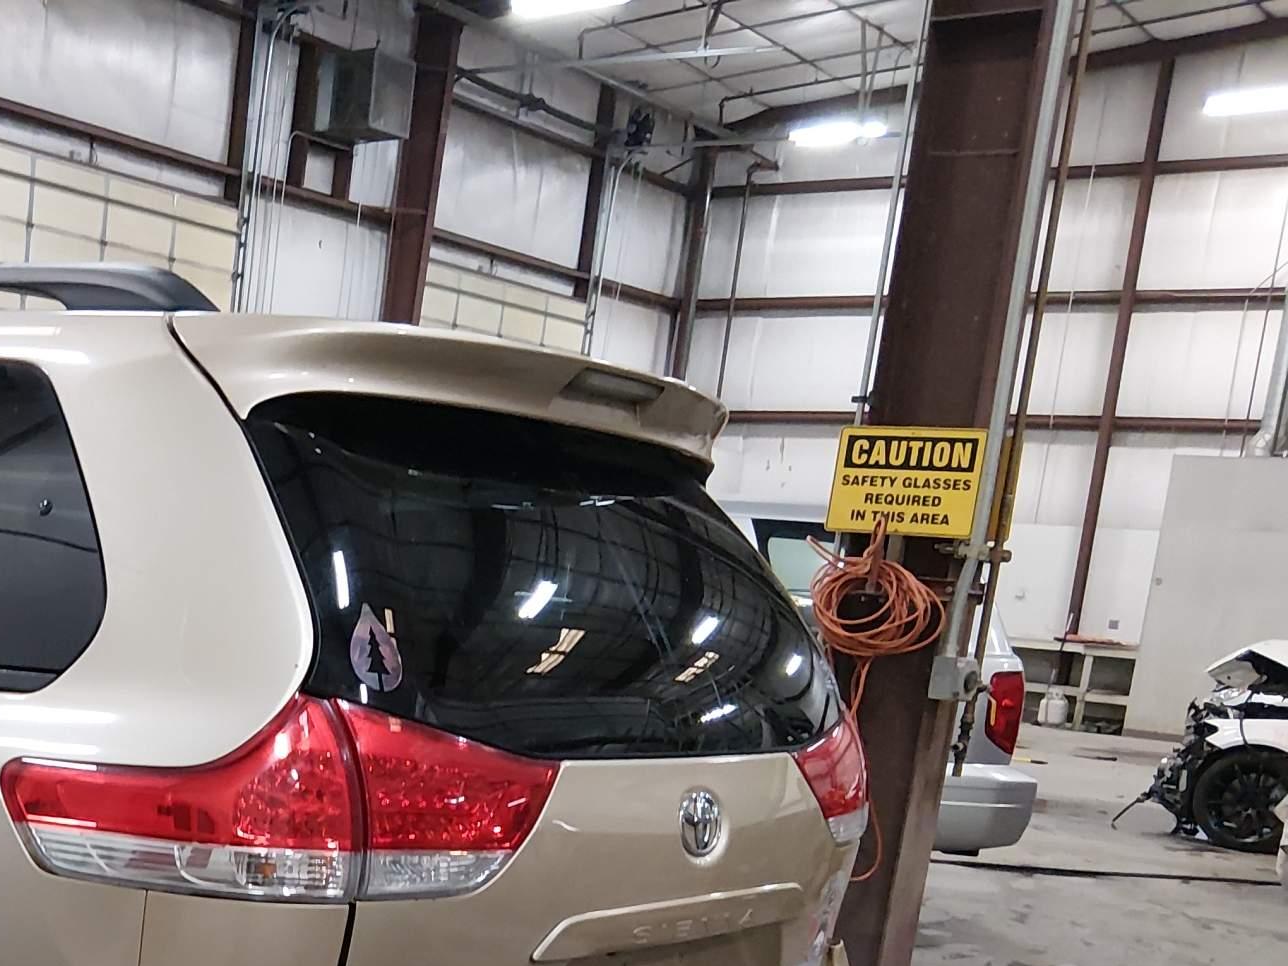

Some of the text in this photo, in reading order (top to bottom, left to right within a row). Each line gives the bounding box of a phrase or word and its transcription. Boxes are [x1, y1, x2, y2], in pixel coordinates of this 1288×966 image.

[851, 438, 973, 469] CAUTION
[841, 474, 972, 492] SAFETY GLASSES
[863, 492, 942, 508] REQUIRED
[850, 509, 867, 521] IN
[909, 512, 950, 526] AREA
